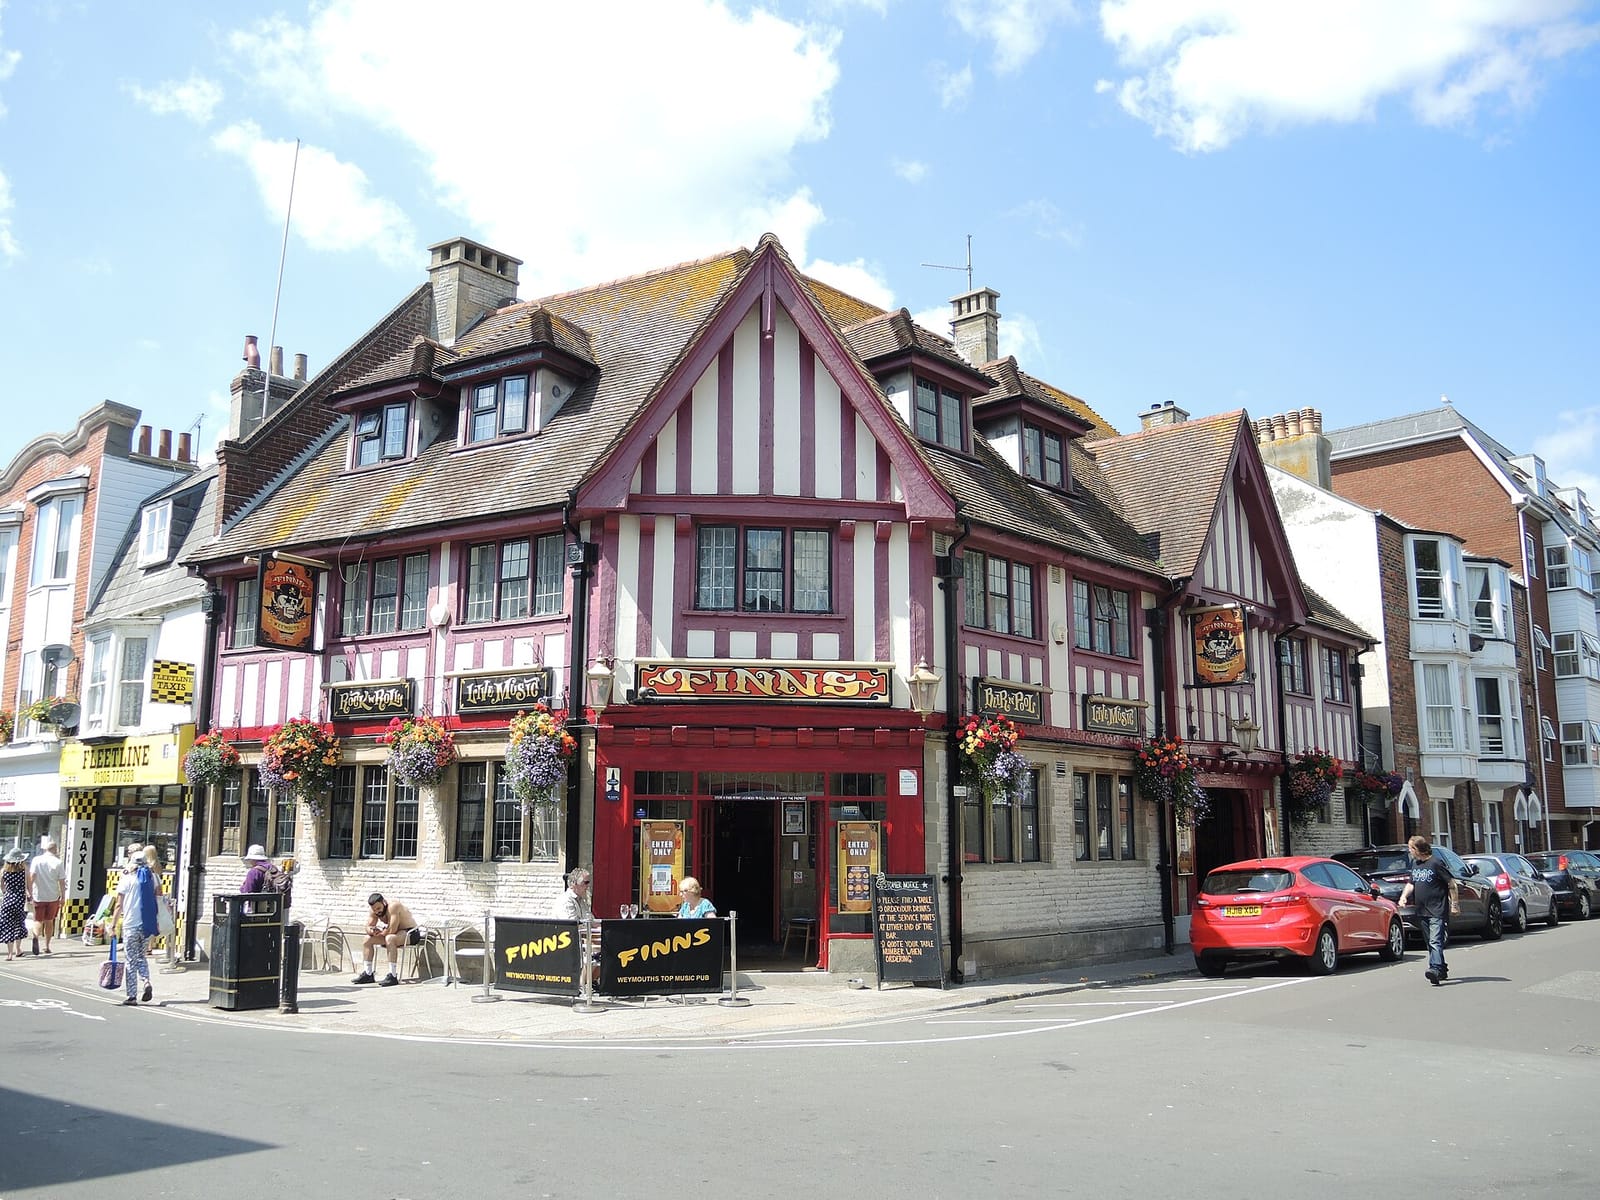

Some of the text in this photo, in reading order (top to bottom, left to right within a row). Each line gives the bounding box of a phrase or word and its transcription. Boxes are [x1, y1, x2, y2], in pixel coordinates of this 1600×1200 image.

[152, 673, 193, 683] FLEETLINE
[649, 667, 879, 697] FINNS
[157, 681, 186, 691] TAXIS
[466, 677, 540, 704] LIVE MUSIC
[1011, 691, 1036, 713] POOL
[1092, 703, 1134, 726] LIVE MUSIC
[82, 745, 150, 769] FLEETLINE
[651, 840, 674, 848] ENTER
[653, 848, 672, 856] ONLY
[849, 848, 868, 856] ONLY
[77, 828, 88, 891] TAXIS
[882, 896, 900, 904] PLEASE
[901, 896, 913, 904] FIND
[917, 896, 933, 904] TABLE
[883, 905, 899, 913] ORDER
[898, 905, 912, 913] YOUR
[912, 905, 931, 913] DRINKS
[879, 913, 936, 922] AT THE SERVICE POINTS
[886, 923, 904, 931] EITHER
[904, 923, 914, 931] END
[915, 923, 922, 931] OF
[923, 922, 933, 931] THE
[505, 931, 572, 965] FINNS
[617, 928, 711, 968] FINNS
[886, 940, 904, 948] QUOTE
[905, 940, 919, 948] YOUR
[919, 940, 935, 948] TABLE
[882, 948, 922, 956] NUMBER WHEN
[505, 971, 535, 981] WEYMOUTHS
[545, 975, 560, 983] MUSIC
[560, 976, 572, 984] PUB
[617, 975, 660, 983] WEYMOUTHS
